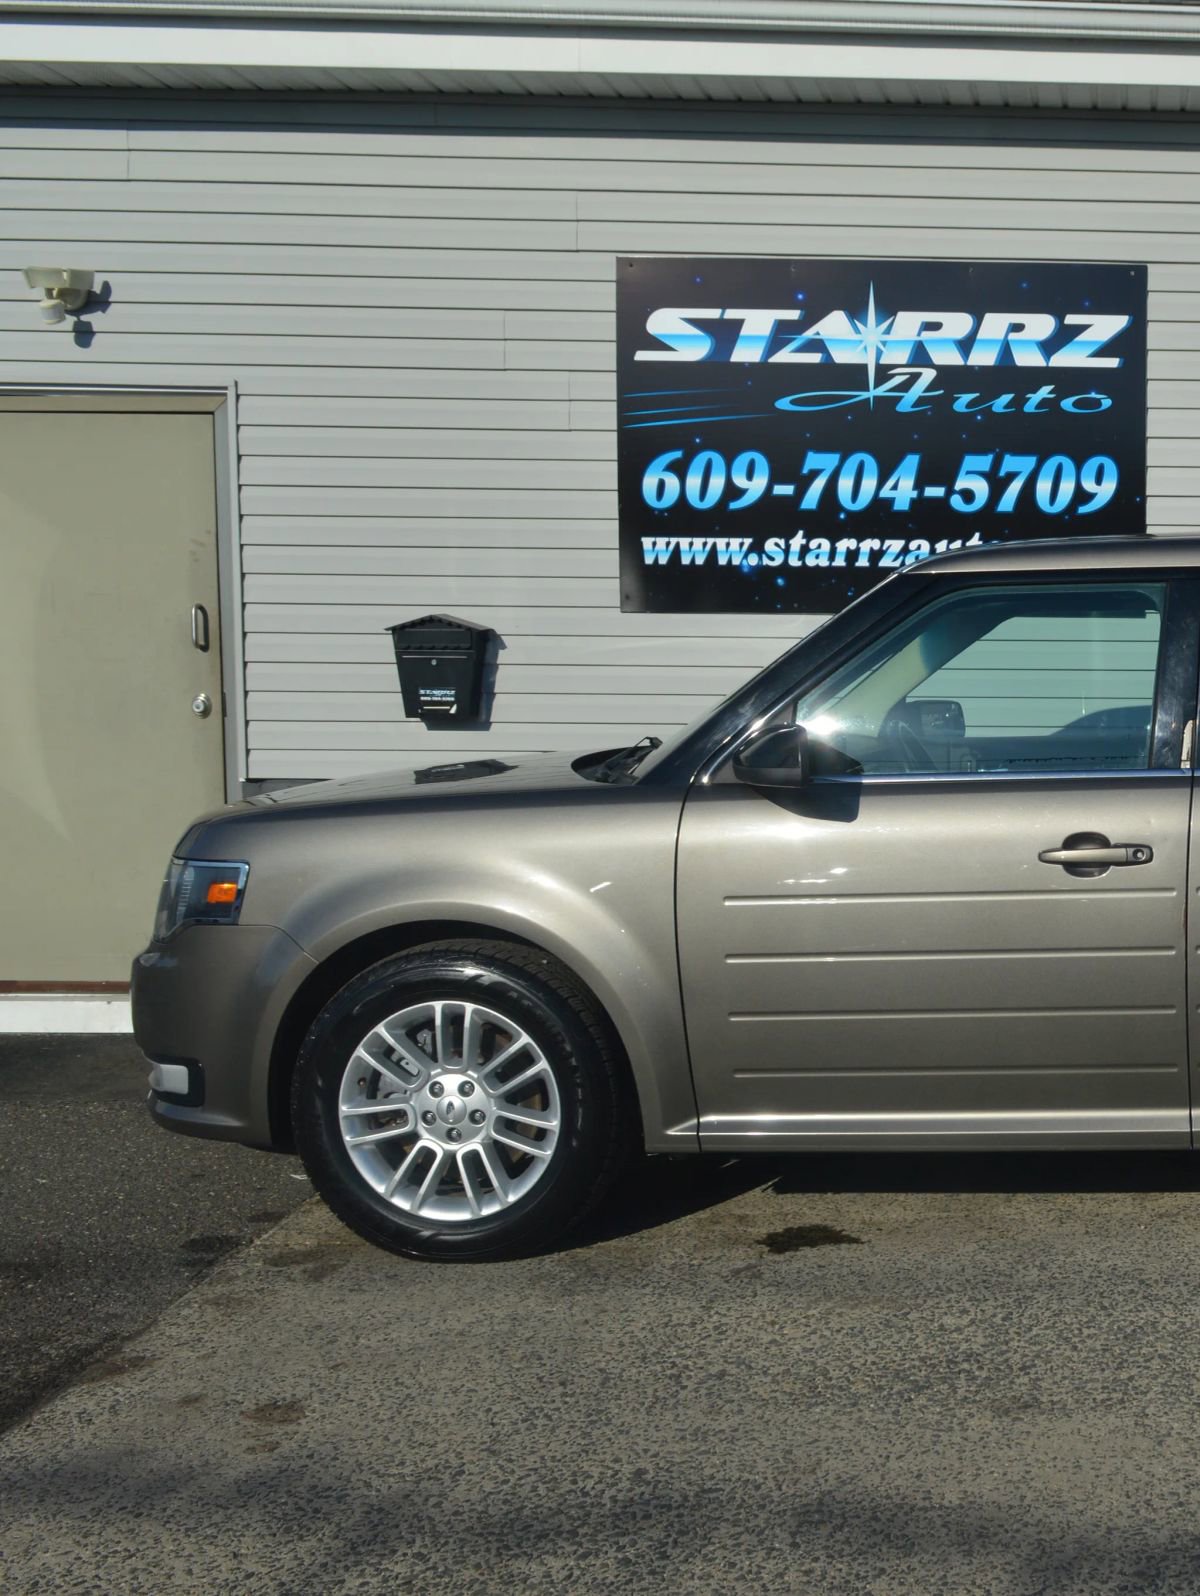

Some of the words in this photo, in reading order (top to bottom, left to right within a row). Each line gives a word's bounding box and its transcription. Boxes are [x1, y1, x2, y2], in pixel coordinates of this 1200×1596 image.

[634, 307, 1133, 368] STARRZ
[774, 367, 1113, 413] Auto
[641, 449, 1120, 514] 609-704-5709
[641, 530, 1000, 568] www.starrza
